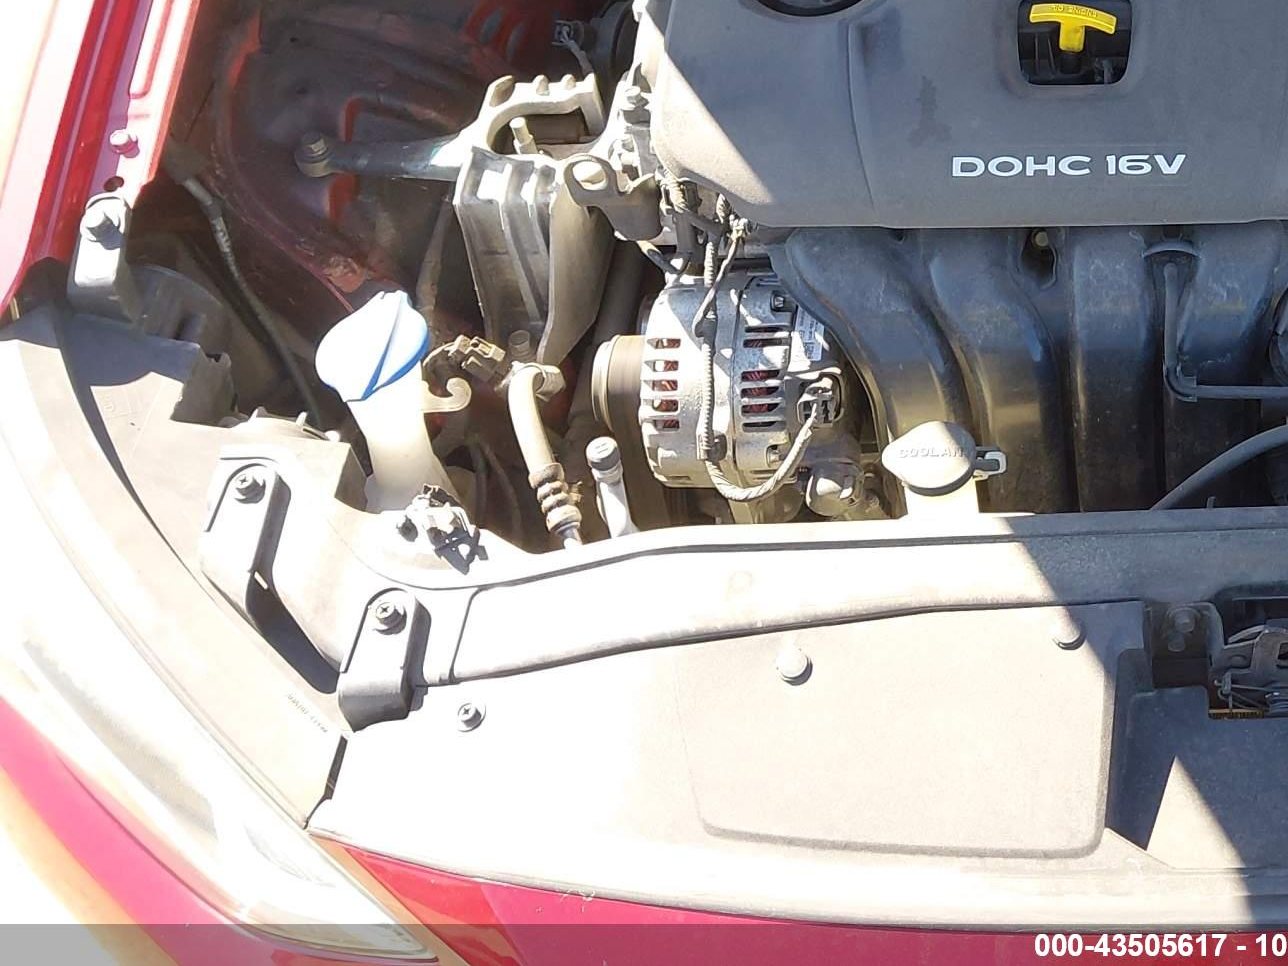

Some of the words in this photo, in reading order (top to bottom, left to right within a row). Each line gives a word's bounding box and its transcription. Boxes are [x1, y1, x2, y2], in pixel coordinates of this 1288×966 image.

[951, 155, 1092, 177] DOHC
[1105, 154, 1187, 175] 16V
[899, 447, 967, 459] COOLAN
